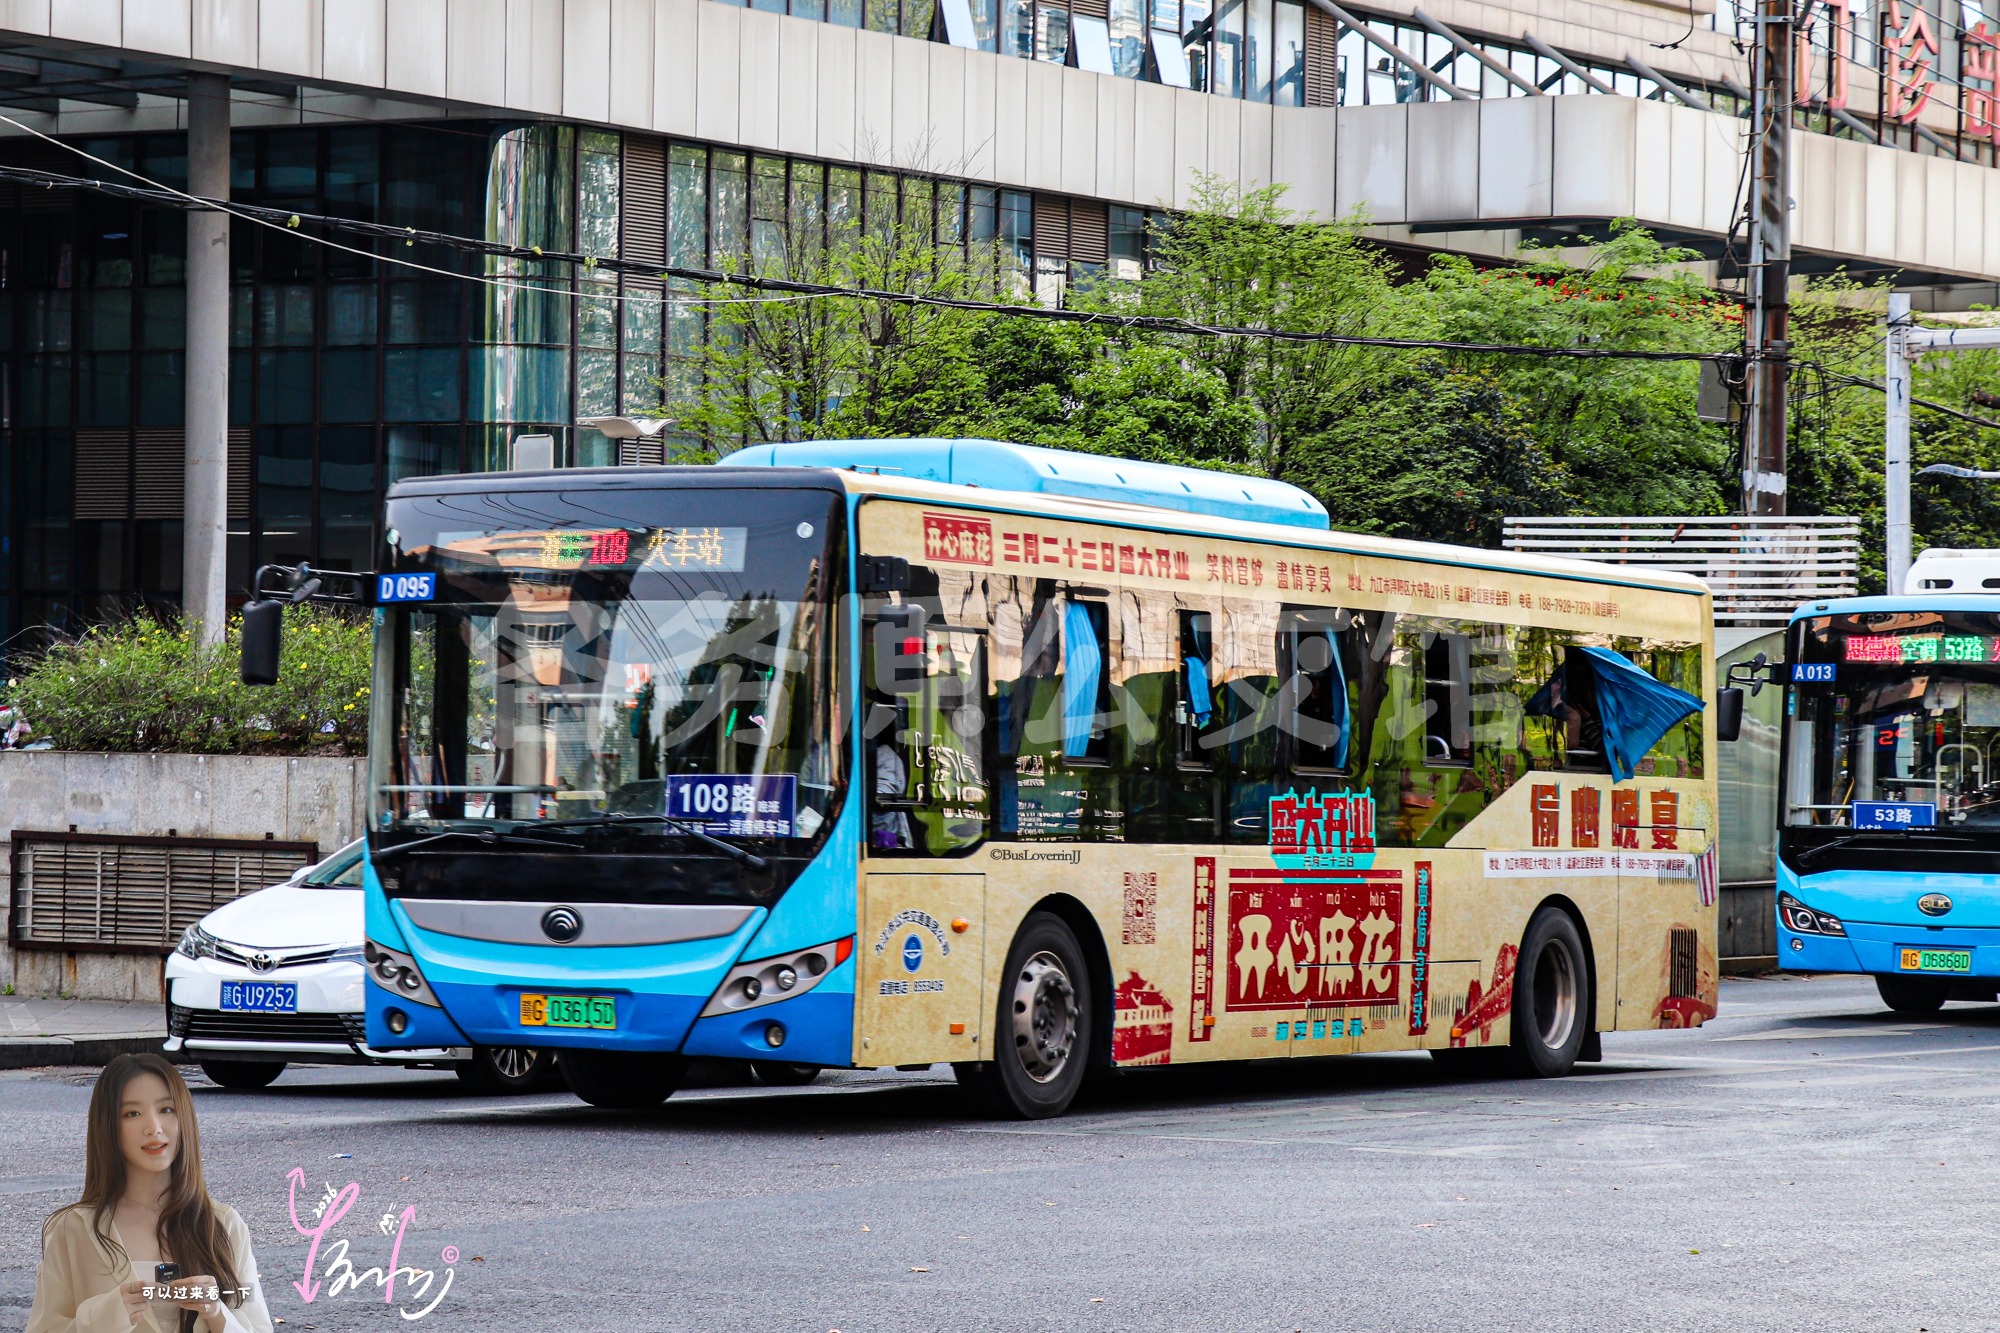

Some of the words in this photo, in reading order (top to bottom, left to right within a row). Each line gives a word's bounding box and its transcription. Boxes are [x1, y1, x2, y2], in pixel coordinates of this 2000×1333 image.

[590, 530, 630, 566] 108
[644, 527, 725, 566] 火车站
[927, 527, 991, 562] 开心麻花
[1002, 532, 1190, 581] 三月二十三日盛大开业
[1206, 553, 1263, 587] 笑料管够
[381, 577, 394, 599] D
[396, 576, 430, 598] 095
[1900, 636, 1937, 661] 空调
[1943, 636, 1985, 661] 53路
[1795, 666, 1804, 680] A
[1807, 666, 1832, 680] 013
[679, 783, 756, 813] 108路
[1270, 794, 1376, 855] 盛大开业
[1875, 808, 1912, 823] 53路
[1303, 856, 1354, 868] 三月二十三日
[1234, 908, 1396, 999] 开心麻花
